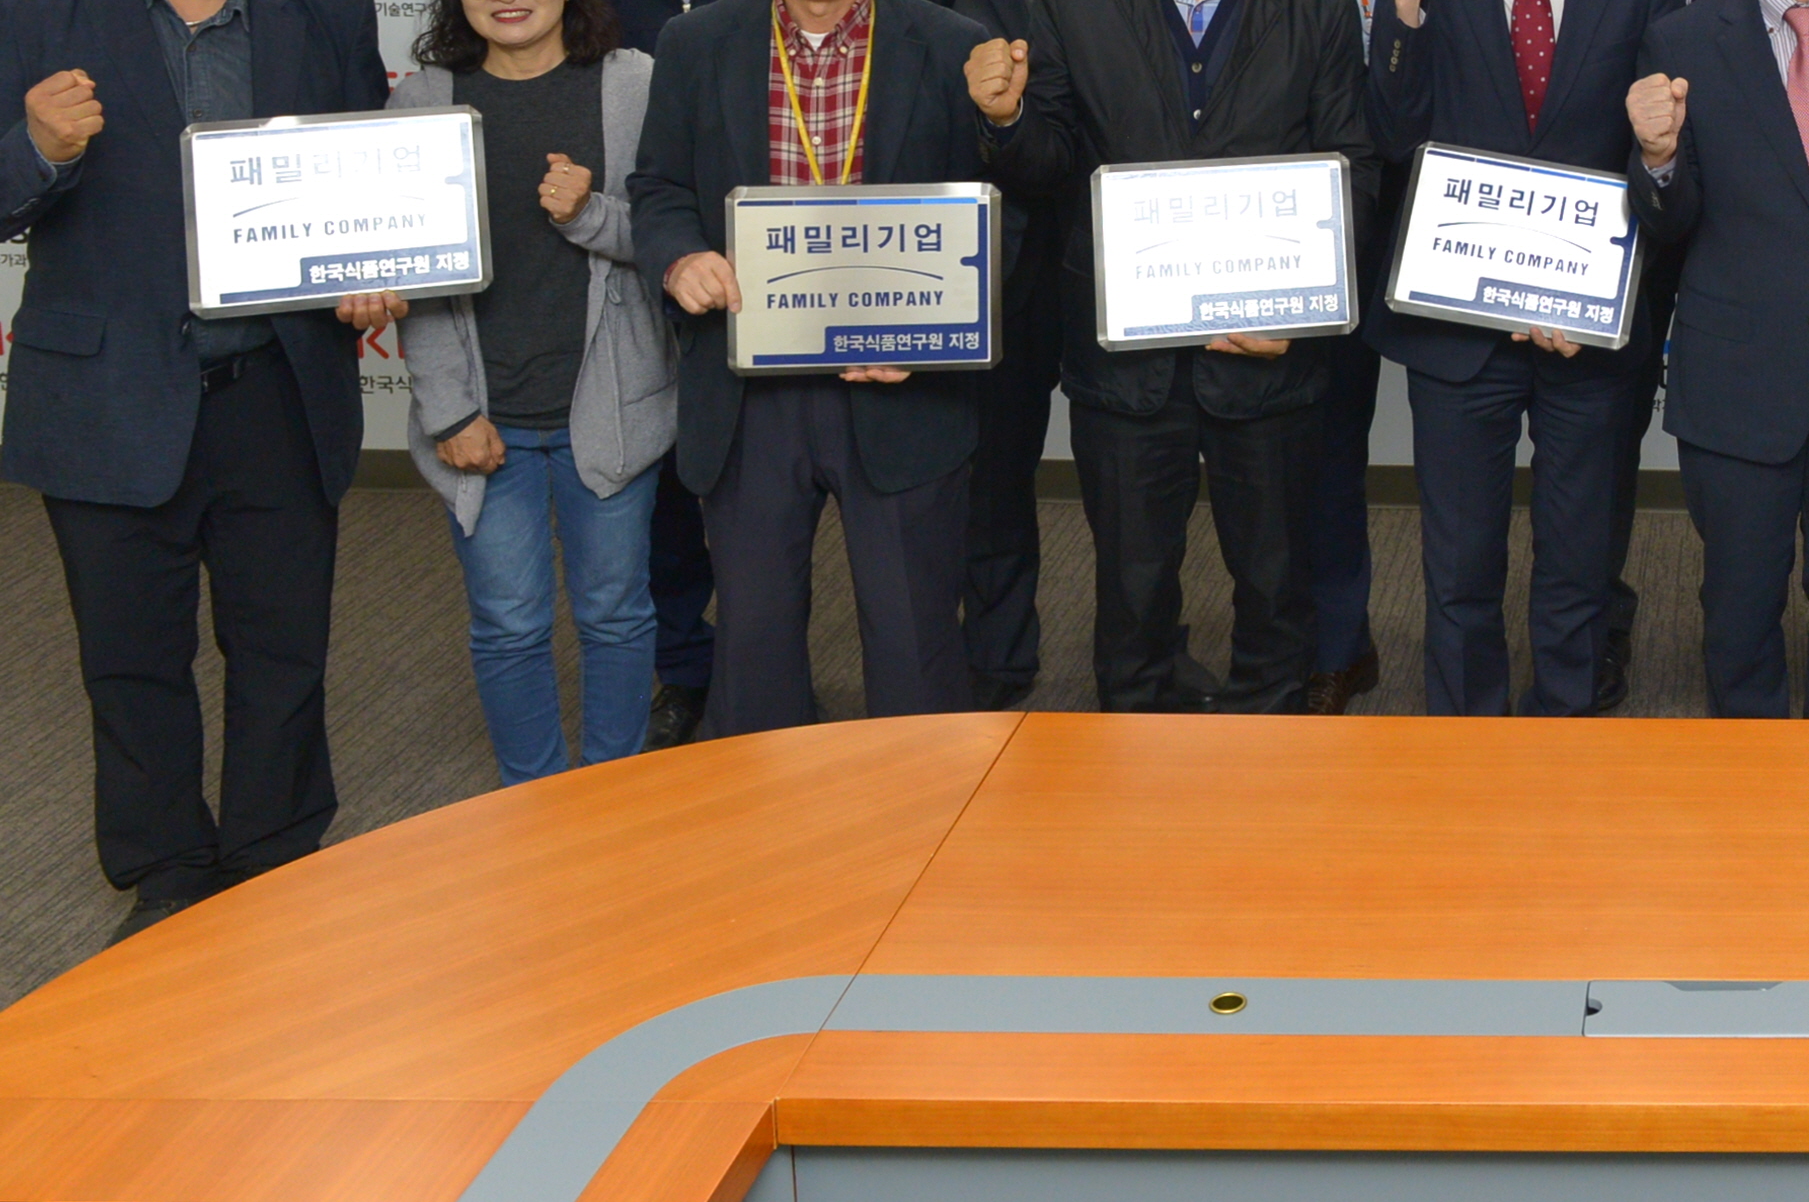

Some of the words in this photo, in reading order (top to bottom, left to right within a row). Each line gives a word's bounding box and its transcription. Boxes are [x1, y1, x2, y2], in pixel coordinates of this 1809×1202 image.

[230, 145, 422, 186] 패밀리기업
[1133, 189, 1299, 225] 패밀리기업
[1442, 175, 1600, 227] 패밀리기업
[233, 222, 312, 244] FAMILY
[324, 213, 426, 235] COMPANY
[766, 222, 943, 254] 패밀리기업
[309, 253, 430, 284] 한국식품연구원
[436, 250, 470, 271] 지정
[1135, 262, 1201, 279] FAMILY
[1211, 255, 1302, 274] COMPANY
[1433, 237, 1496, 260] FAMILY
[1504, 249, 1588, 275] COMPANY
[767, 292, 838, 308] FAMILY
[848, 290, 943, 306] COMPANY
[1199, 297, 1303, 320] 한국식품연구원
[1308, 295, 1339, 313] 지정
[1482, 284, 1582, 319] 한국식품연구원
[1585, 303, 1614, 324] 지정
[833, 332, 943, 351] 한국식품연구원
[949, 331, 980, 350] 지정
